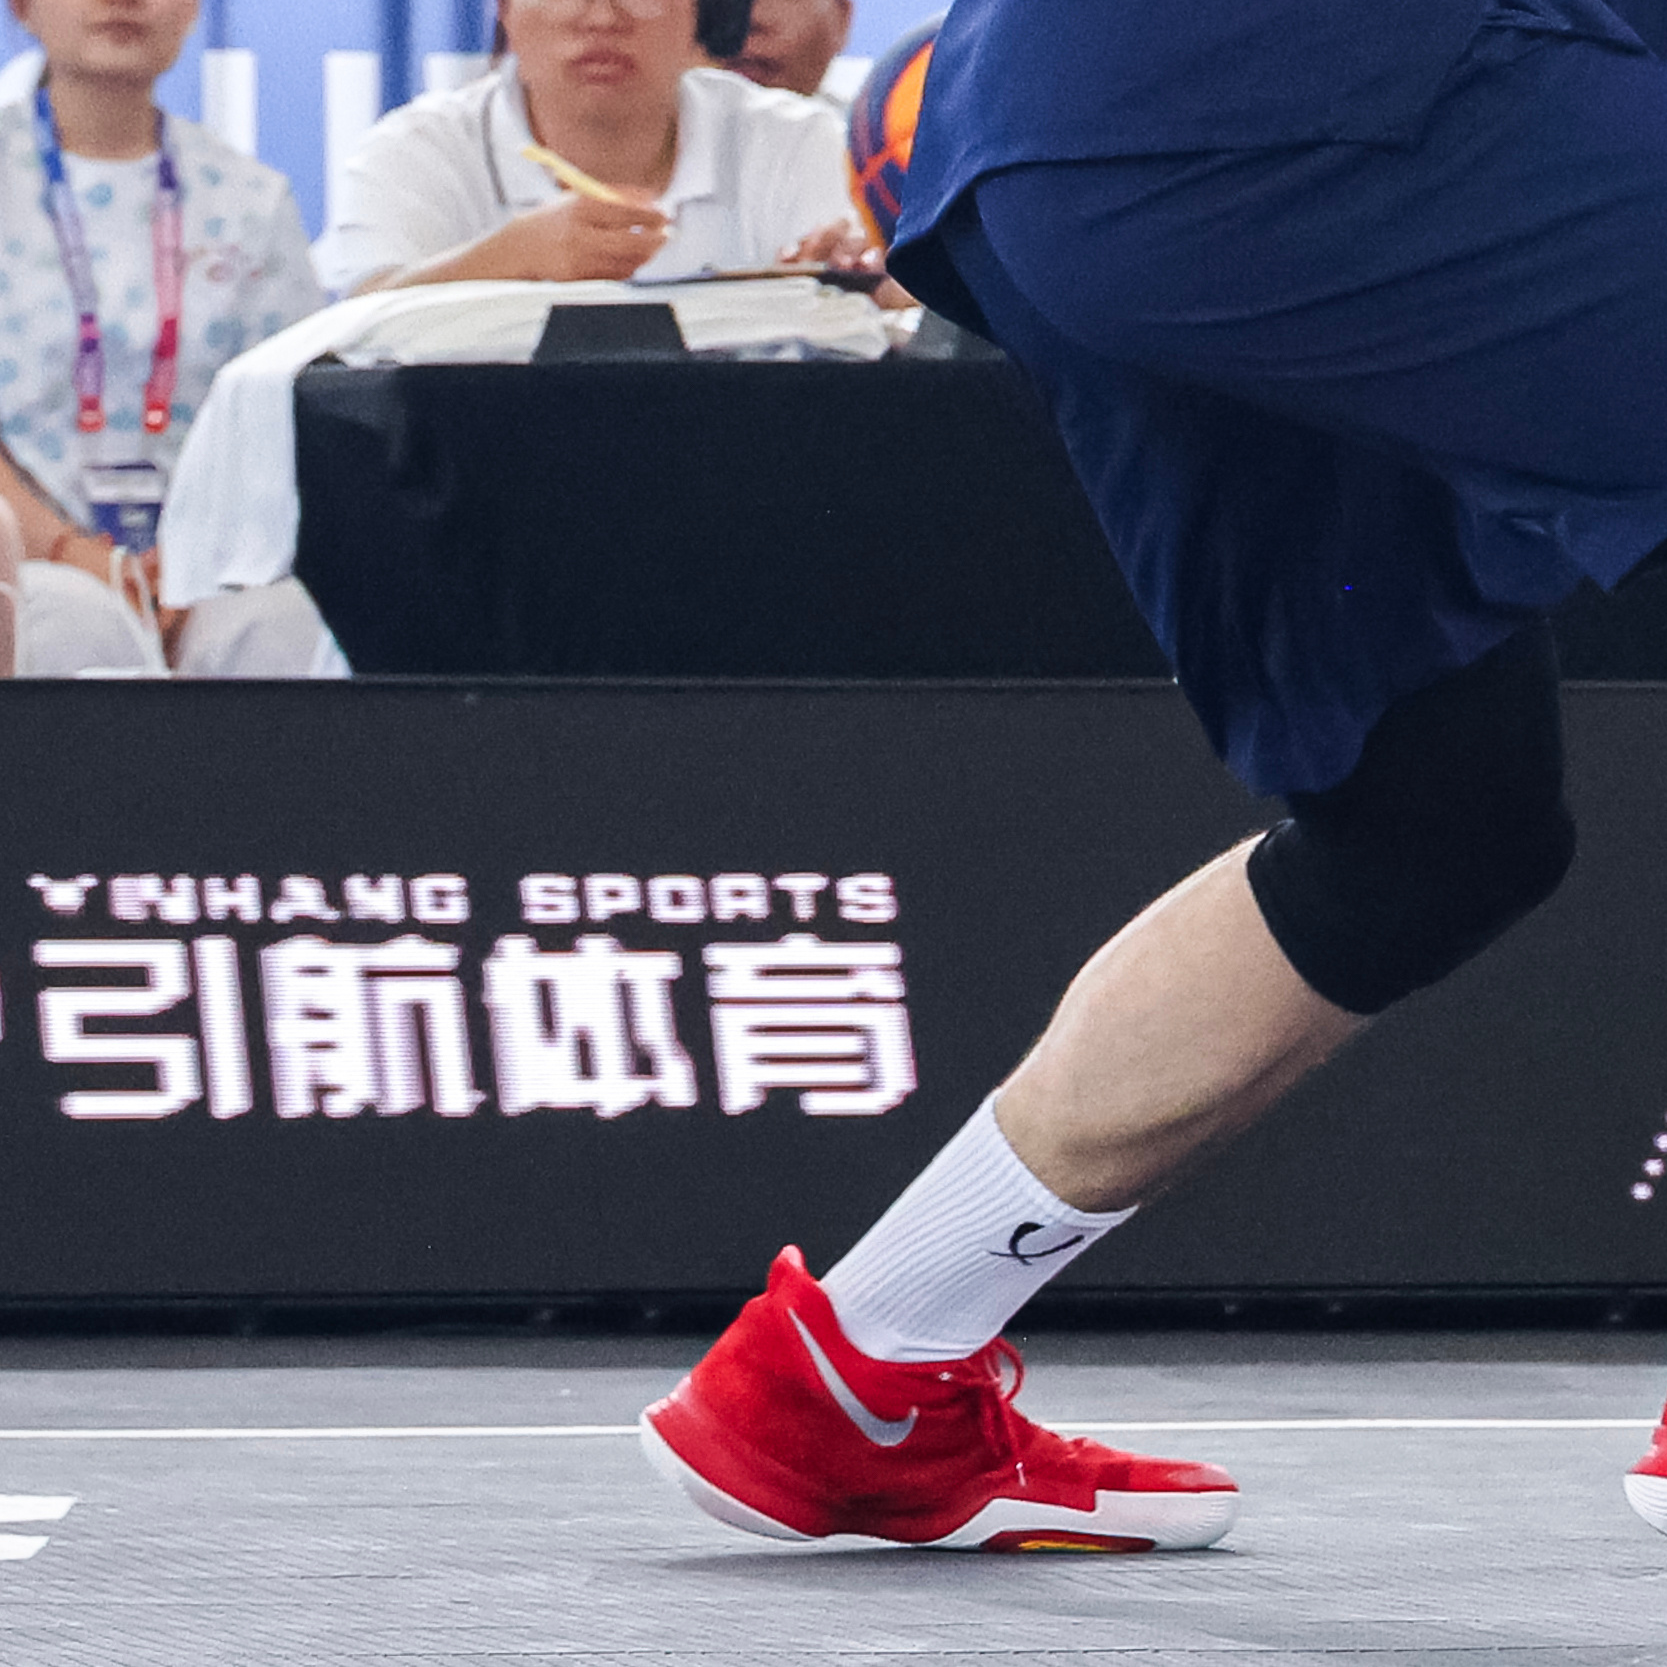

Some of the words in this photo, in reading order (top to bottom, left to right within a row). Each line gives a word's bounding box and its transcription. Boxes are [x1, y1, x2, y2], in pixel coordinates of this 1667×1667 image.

[27, 873, 471, 925] YINHANG
[519, 873, 899, 924] SPORTS
[31, 934, 918, 1120] 引航体育
